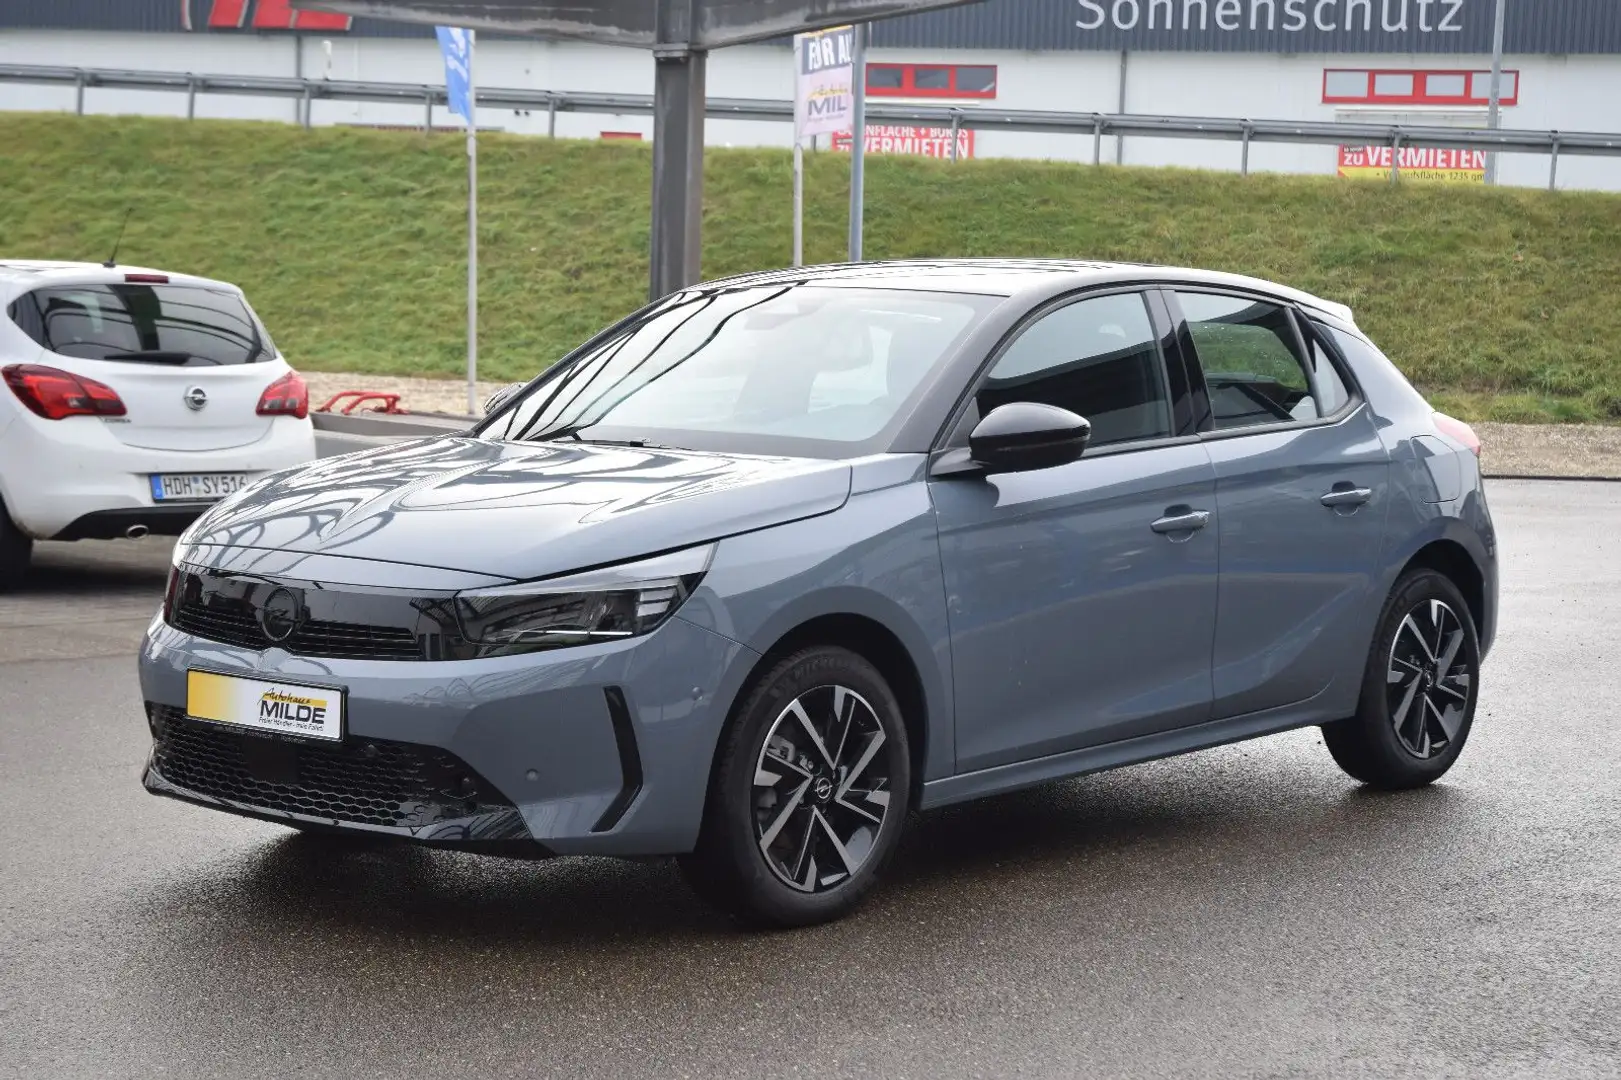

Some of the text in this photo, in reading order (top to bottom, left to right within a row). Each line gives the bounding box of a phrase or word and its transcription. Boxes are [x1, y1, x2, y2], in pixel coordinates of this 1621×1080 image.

[1075, 0, 1463, 32] Sonnenschutz
[1366, 146, 1487, 169] VERMIETEN
[163, 477, 193, 496] HDH
[260, 700, 327, 724] MILDE
